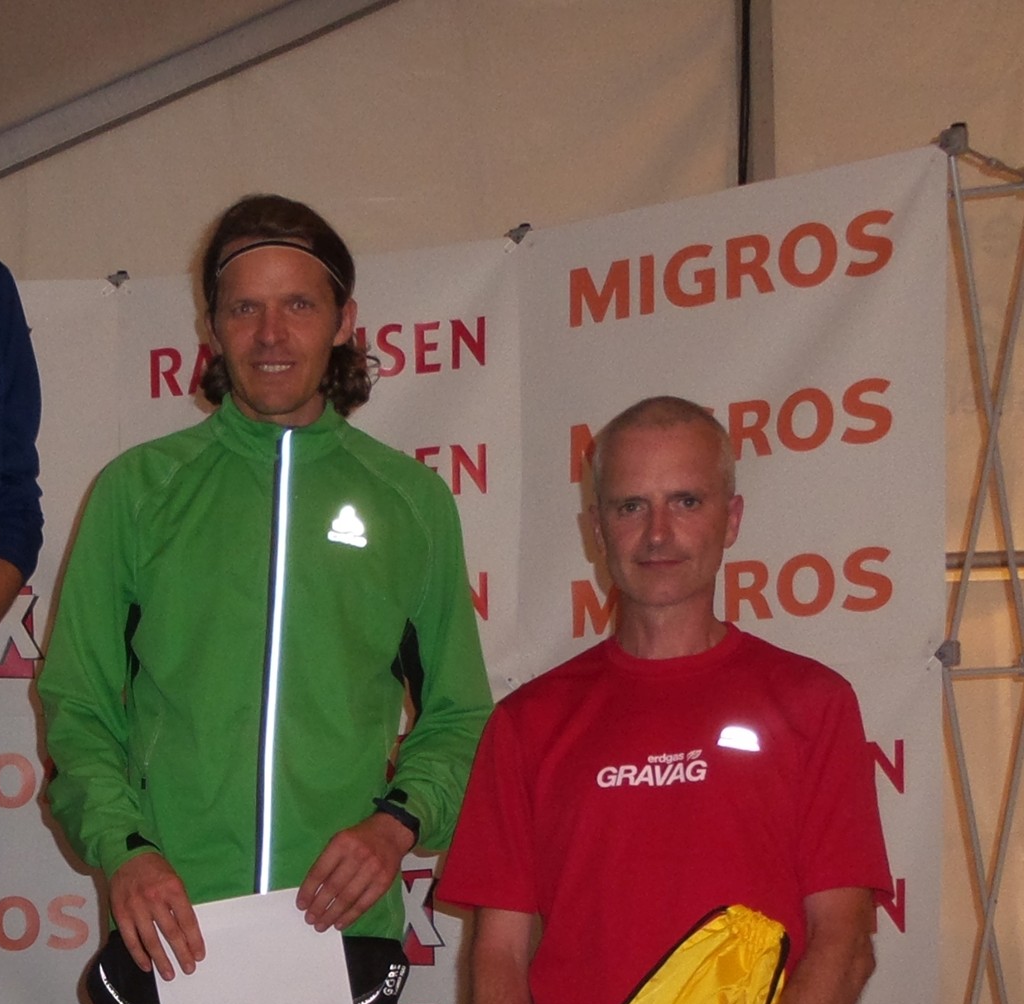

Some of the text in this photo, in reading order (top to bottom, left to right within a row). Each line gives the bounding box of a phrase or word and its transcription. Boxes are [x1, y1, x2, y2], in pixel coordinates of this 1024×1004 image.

[569, 210, 894, 328] MIGROS
[571, 546, 893, 638] MROS
[597, 760, 707, 787] GRAVAG
[647, 753, 684, 764] erdgas
